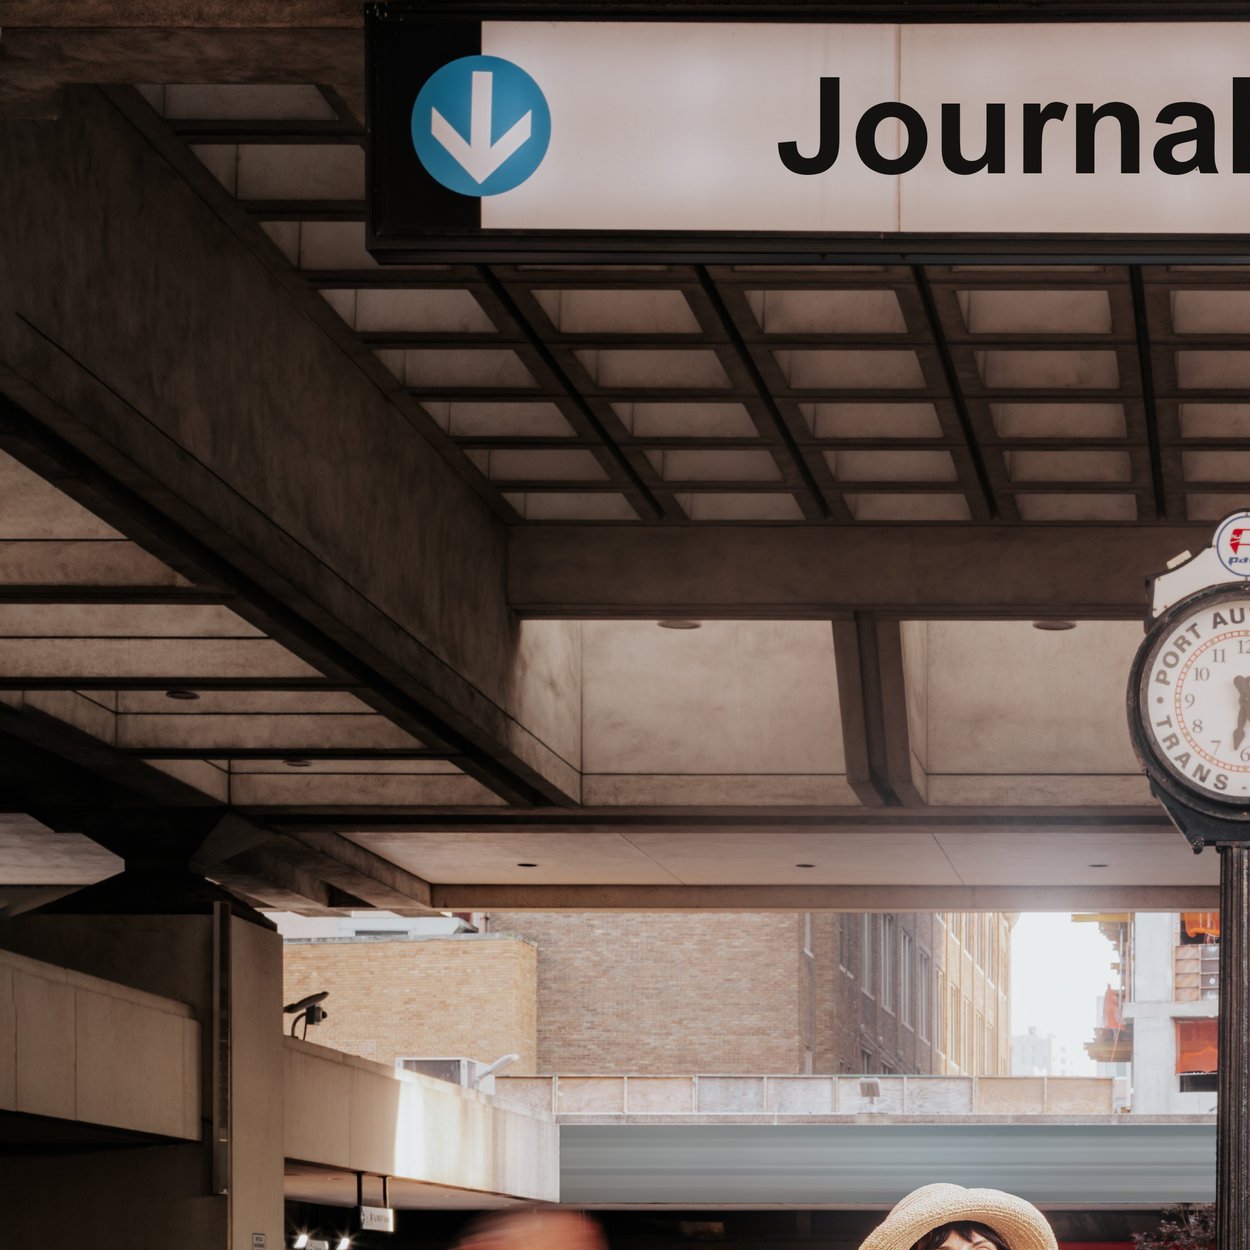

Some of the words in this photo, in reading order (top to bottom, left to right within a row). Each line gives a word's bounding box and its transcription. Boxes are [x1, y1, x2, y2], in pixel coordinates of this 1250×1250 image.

[1155, 622, 1201, 686] PORT
[1212, 648, 1226, 663] 11
[1194, 667, 1210, 681] 10
[1184, 694, 1195, 709] 9
[1192, 719, 1203, 733] 8
[1156, 714, 1229, 790] TRANS
[1210, 740, 1221, 755] 7
[1240, 746, 1250, 762] 6
